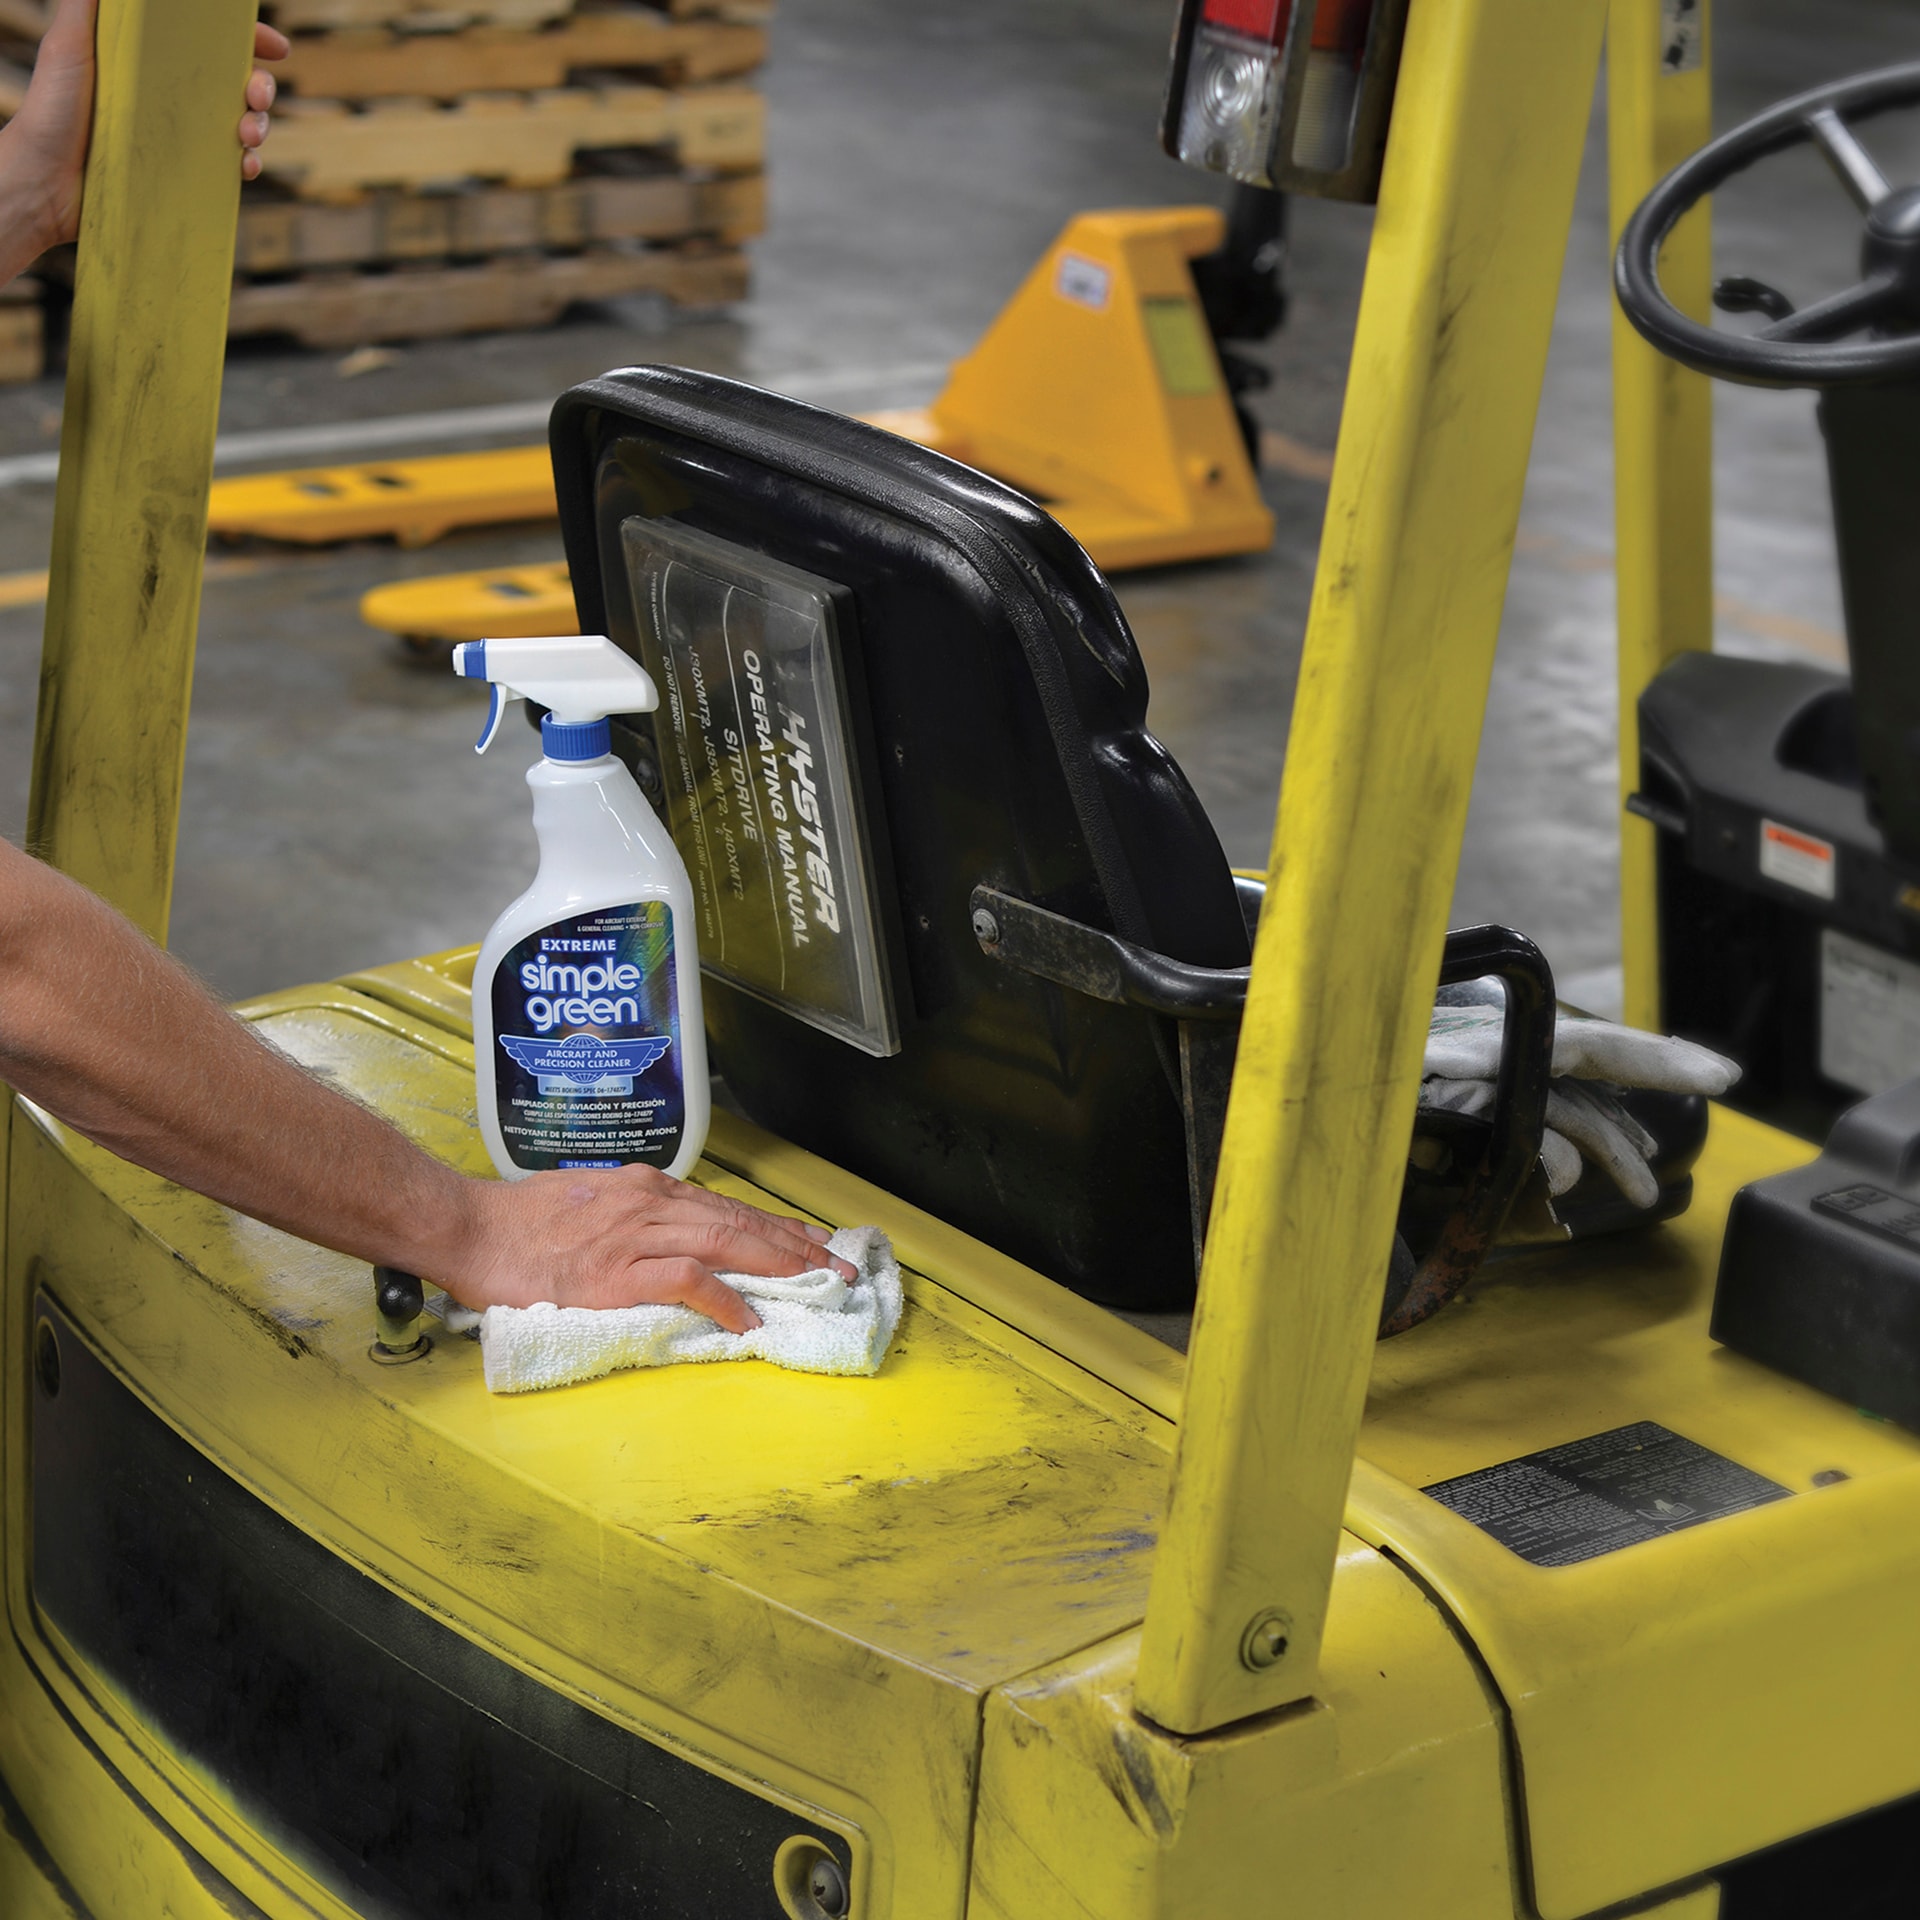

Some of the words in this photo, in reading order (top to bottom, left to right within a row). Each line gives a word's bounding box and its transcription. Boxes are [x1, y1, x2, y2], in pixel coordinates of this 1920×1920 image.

[652, 603, 661, 641] COMPANY
[662, 656, 672, 671] DO
[666, 672, 677, 693] NOT
[670, 692, 682, 734] REMOVE
[680, 756, 693, 793] MANUAL
[723, 728, 758, 842] SITDRIVE
[688, 794, 700, 822] FROM
[743, 649, 788, 822] OPERATING
[776, 826, 810, 948] MANUAL
[704, 735, 729, 816] J35XMT2,
[722, 822, 744, 901] J40XMT2
[777, 701, 840, 933] HYSTER
[693, 823, 704, 847] THIS
[696, 846, 708, 868] UNIT
[541, 939, 616, 950] EXTREME
[522, 954, 640, 999] simple
[526, 996, 638, 1032] green
[534, 1058, 585, 1068] PRECISION
[588, 1058, 632, 1068] CLEANER
[546, 1050, 592, 1058] AIRCRAFT
[512, 1098, 554, 1109] LIMPIADOR
[569, 1102, 611, 1110] AVIACIÓN
[622, 1098, 666, 1109] PRECISIÓN
[504, 1126, 548, 1138] NETTOYANT
[645, 1126, 678, 1137] AVIONS
